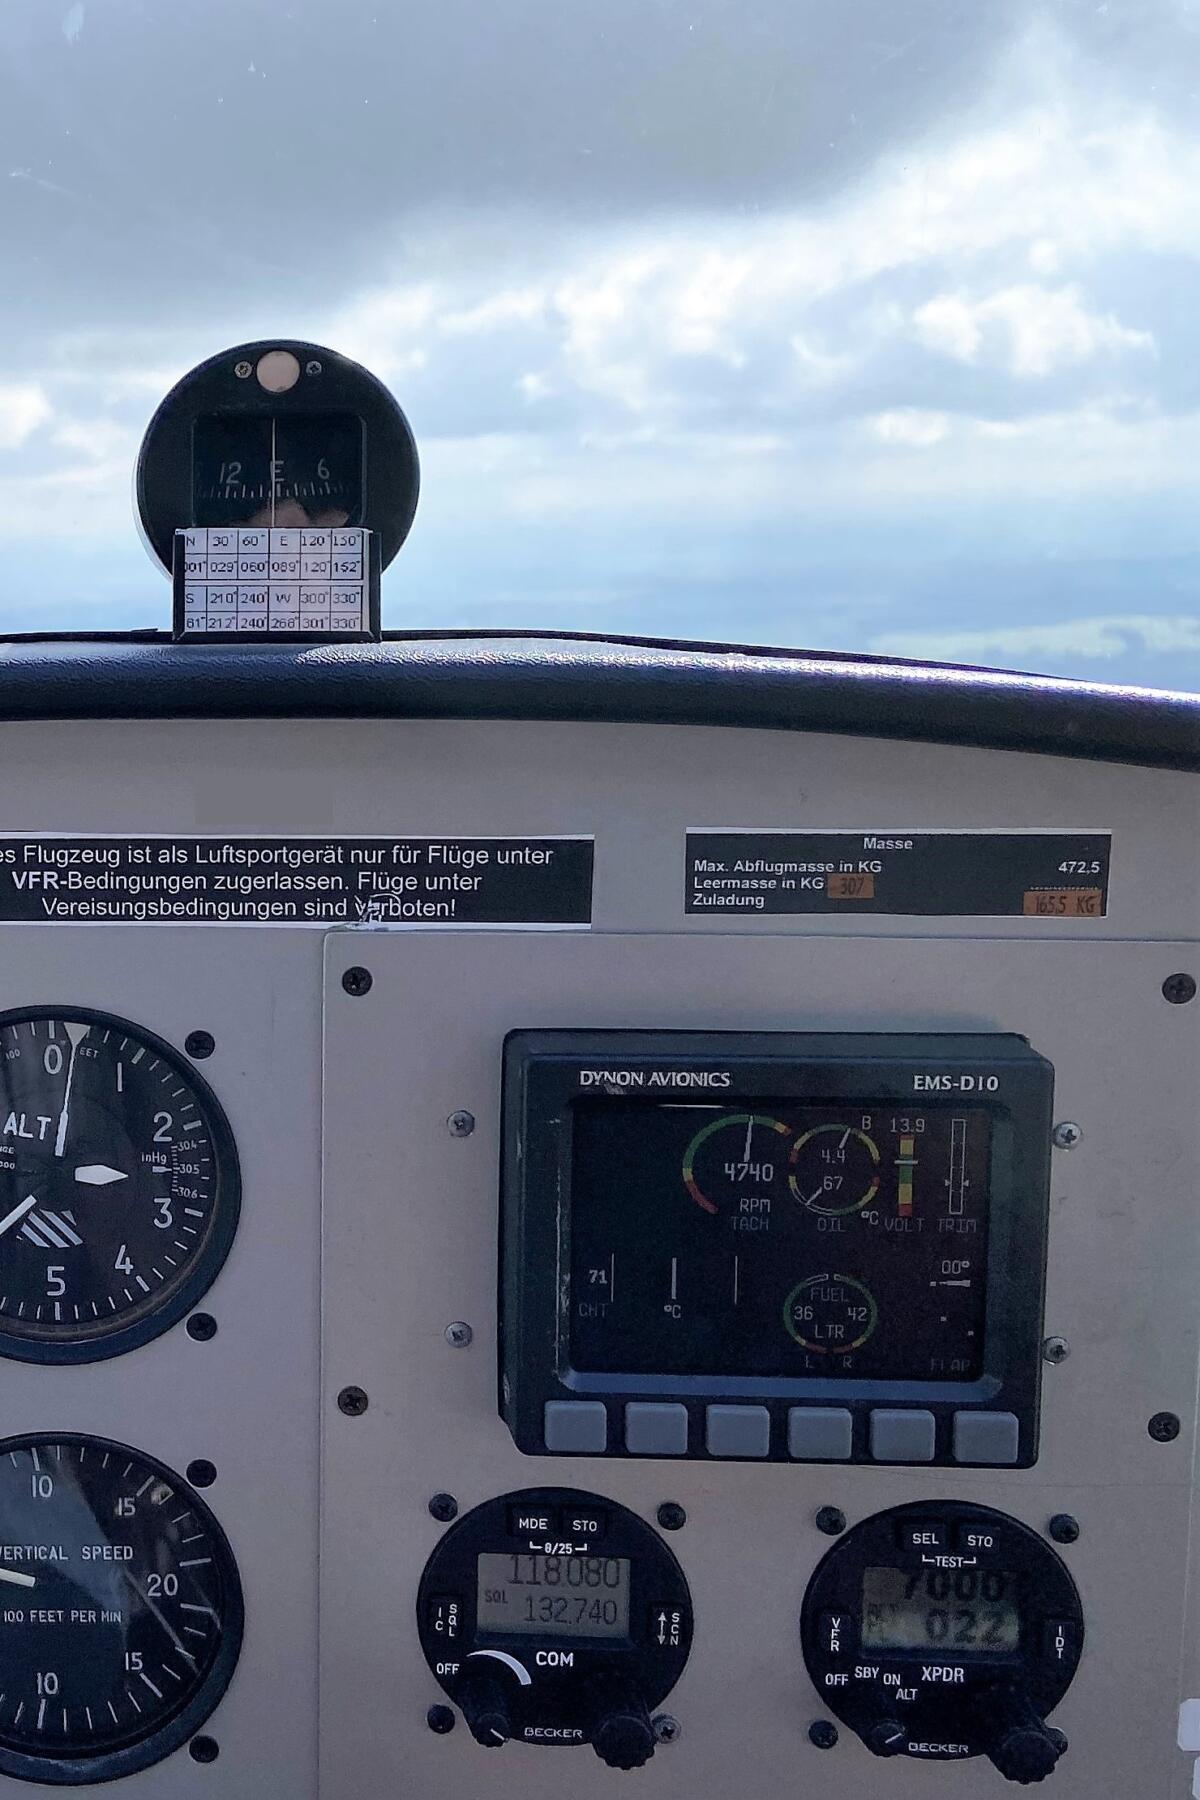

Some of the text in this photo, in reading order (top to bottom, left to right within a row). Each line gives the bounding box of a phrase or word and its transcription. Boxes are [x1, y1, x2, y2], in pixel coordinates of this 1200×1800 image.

[220, 458, 330, 484] 12 E 6
[186, 535, 288, 547] N E
[185, 592, 292, 604] S W
[863, 837, 914, 850] Masse
[23, 845, 119, 867] Flugzeug
[128, 845, 151, 863] ist
[158, 845, 187, 863] als
[195, 845, 343, 865] Luftsportgerät
[350, 849, 385, 864] nur
[391, 845, 421, 864] für
[428, 845, 489, 868] Flüge
[497, 847, 554, 864] unter
[694, 859, 1101, 876] Max. Abflugmasse in KG 472,5
[11, 871, 483, 895] VFR-Bedingungen zugerlassen. Flüge unter
[693, 877, 825, 890] Leermasse in KG
[41, 897, 297, 920] Vereisungsbedingungen
[303, 898, 348, 916] sind
[692, 893, 765, 909] Zuladung
[43, 1043, 63, 1075] 0
[116, 1062, 123, 1092] 1
[579, 1070, 731, 1088] DYNON AVIONICS
[913, 1074, 999, 1092] EMS-D10
[3, 1111, 52, 1140] ALT
[152, 1111, 173, 1143] 2
[889, 1117, 926, 1134] 13.9
[141, 1151, 167, 1165] inHg
[821, 1149, 846, 1164] 4.4
[724, 1163, 774, 1183] 4740
[822, 1175, 844, 1191] 67
[153, 1197, 173, 1228] 3
[739, 1197, 771, 1213] RPM
[731, 1216, 770, 1232] TACH
[817, 1218, 846, 1233] OIL
[884, 1217, 925, 1233] VOLT
[936, 1218, 977, 1233] TRIM
[114, 1244, 134, 1275] 4
[46, 1265, 65, 1297] 5
[588, 1269, 608, 1285] 71
[810, 1287, 850, 1303] FUEL
[793, 1306, 814, 1321] 36
[847, 1306, 868, 1322] 42
[813, 1324, 845, 1340] LTR
[31, 1475, 53, 1499] 10
[118, 1497, 136, 1516] 15
[519, 1518, 598, 1532] MDE STO
[912, 1533, 939, 1545] SEL
[81, 1545, 134, 1561] SPEED
[934, 1556, 964, 1568] TEST
[147, 1573, 179, 1597] 20
[3, 1610, 122, 1624] 100 FEET PER MIN
[524, 1598, 618, 1625] 132.740
[125, 1651, 143, 1672] 15
[535, 1652, 574, 1667] COM
[436, 1663, 460, 1675] OFF
[854, 1666, 880, 1680] SBY
[921, 1666, 964, 1683] XPDR
[36, 1672, 59, 1695] 10
[825, 1674, 849, 1686] OFF
[883, 1673, 901, 1686] ON
[895, 1688, 918, 1701] ALT
[524, 1726, 583, 1739] BECKER
[908, 1742, 969, 1754] BECKER
